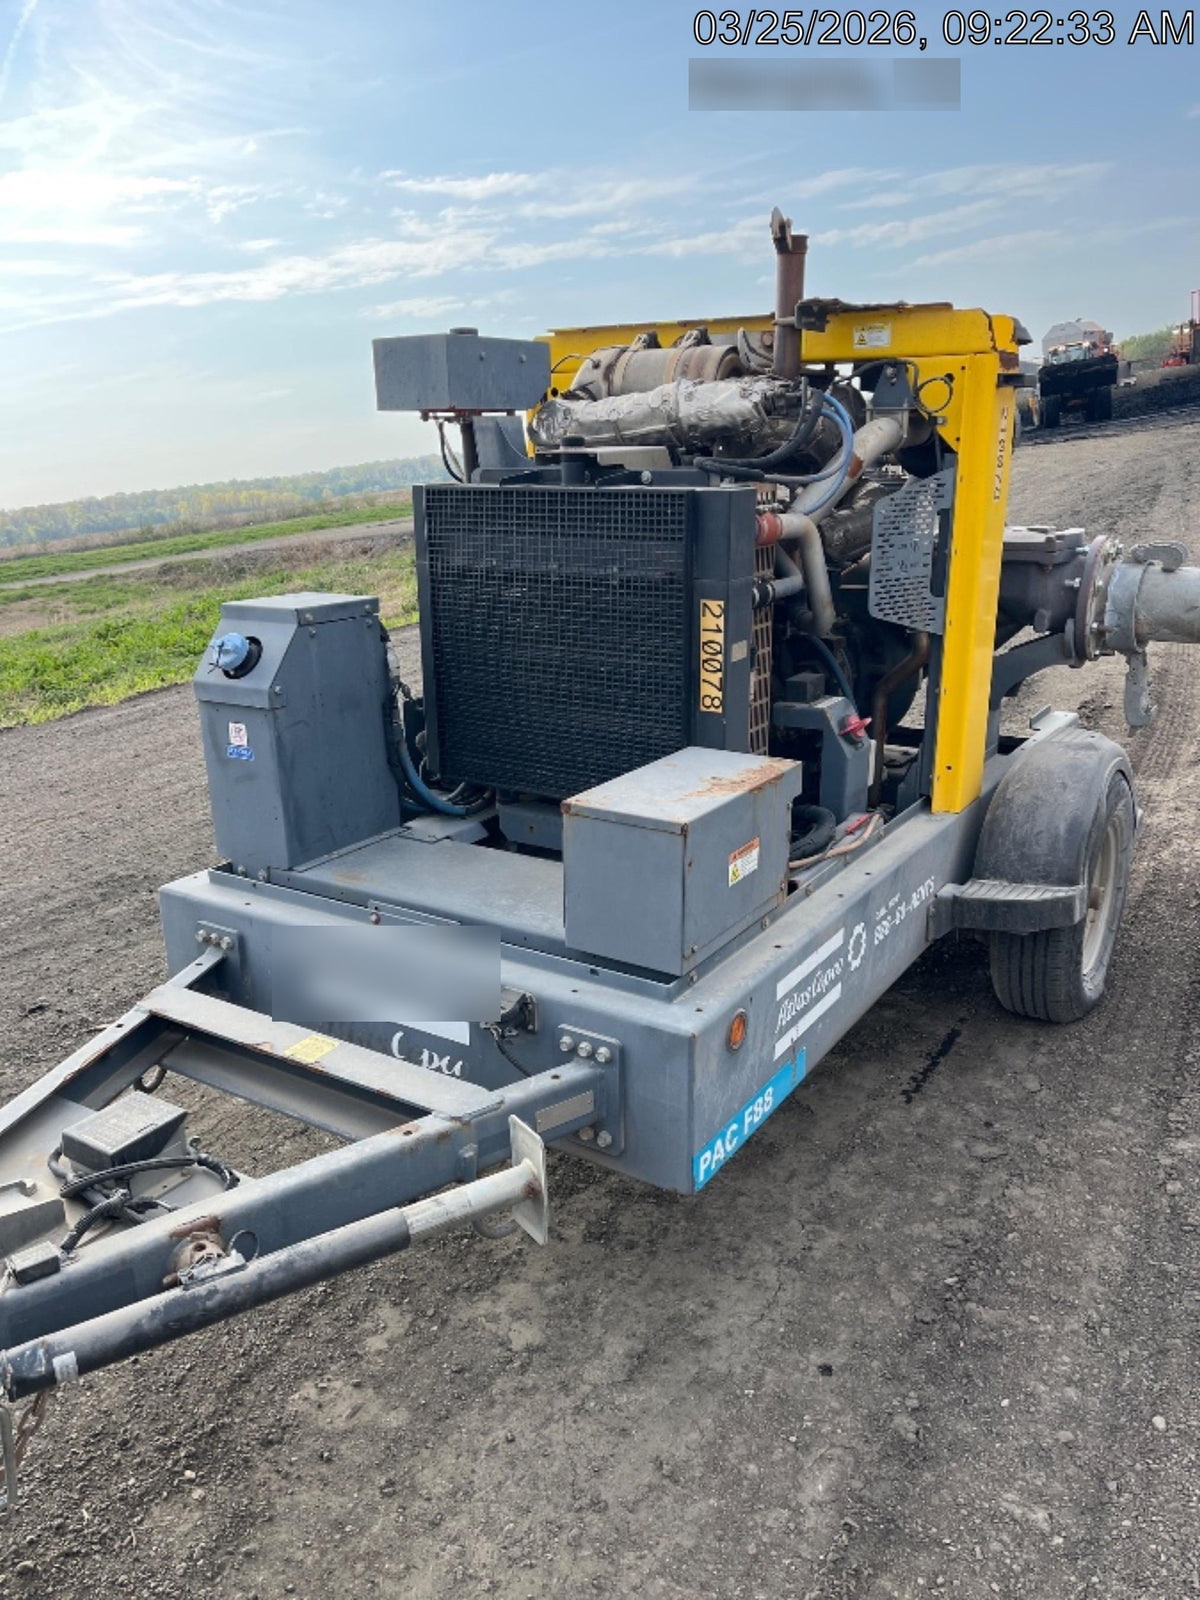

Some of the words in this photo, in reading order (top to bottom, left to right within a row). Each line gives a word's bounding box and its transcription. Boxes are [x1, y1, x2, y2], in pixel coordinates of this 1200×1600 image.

[701, 602, 724, 710] 210078
[699, 1123, 738, 1182] PAC
[743, 1086, 774, 1135] F88
